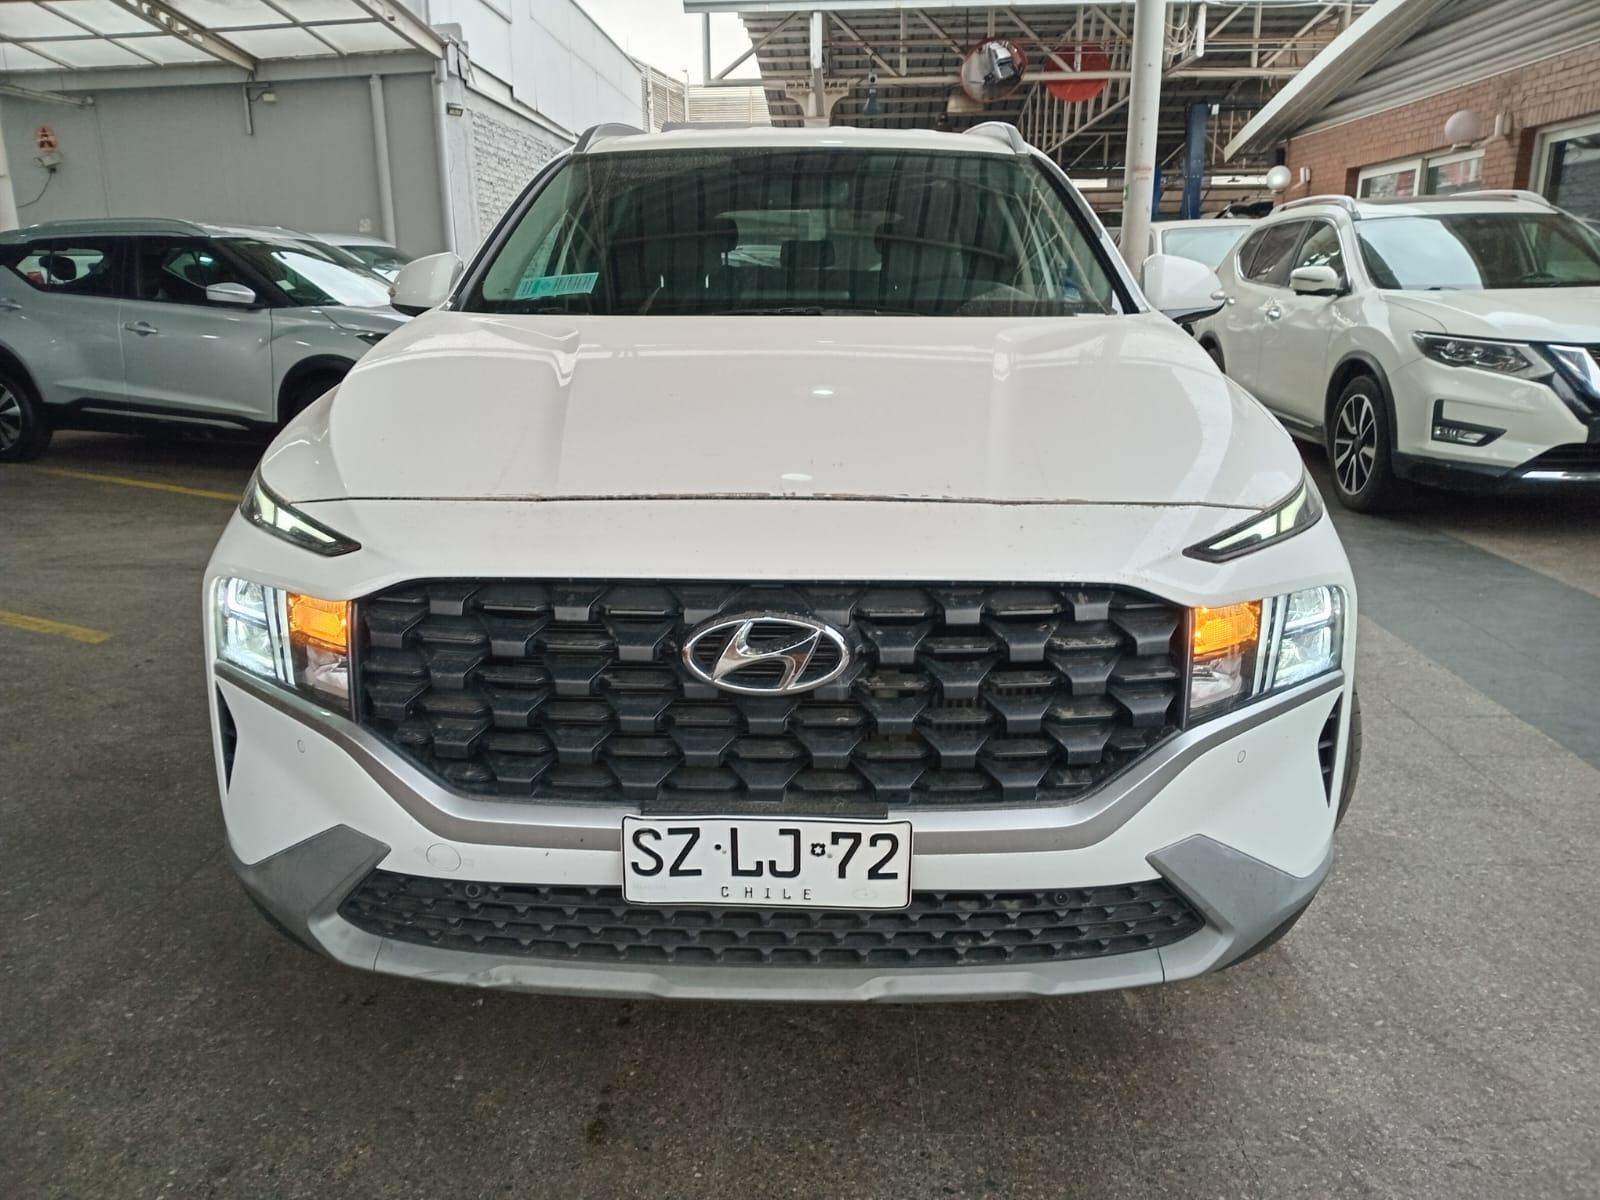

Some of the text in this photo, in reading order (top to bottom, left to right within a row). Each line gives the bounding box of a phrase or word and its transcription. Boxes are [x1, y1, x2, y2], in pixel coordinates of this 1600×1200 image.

[630, 827, 899, 880] SZ LJ 72
[721, 886, 812, 900] CHILE
